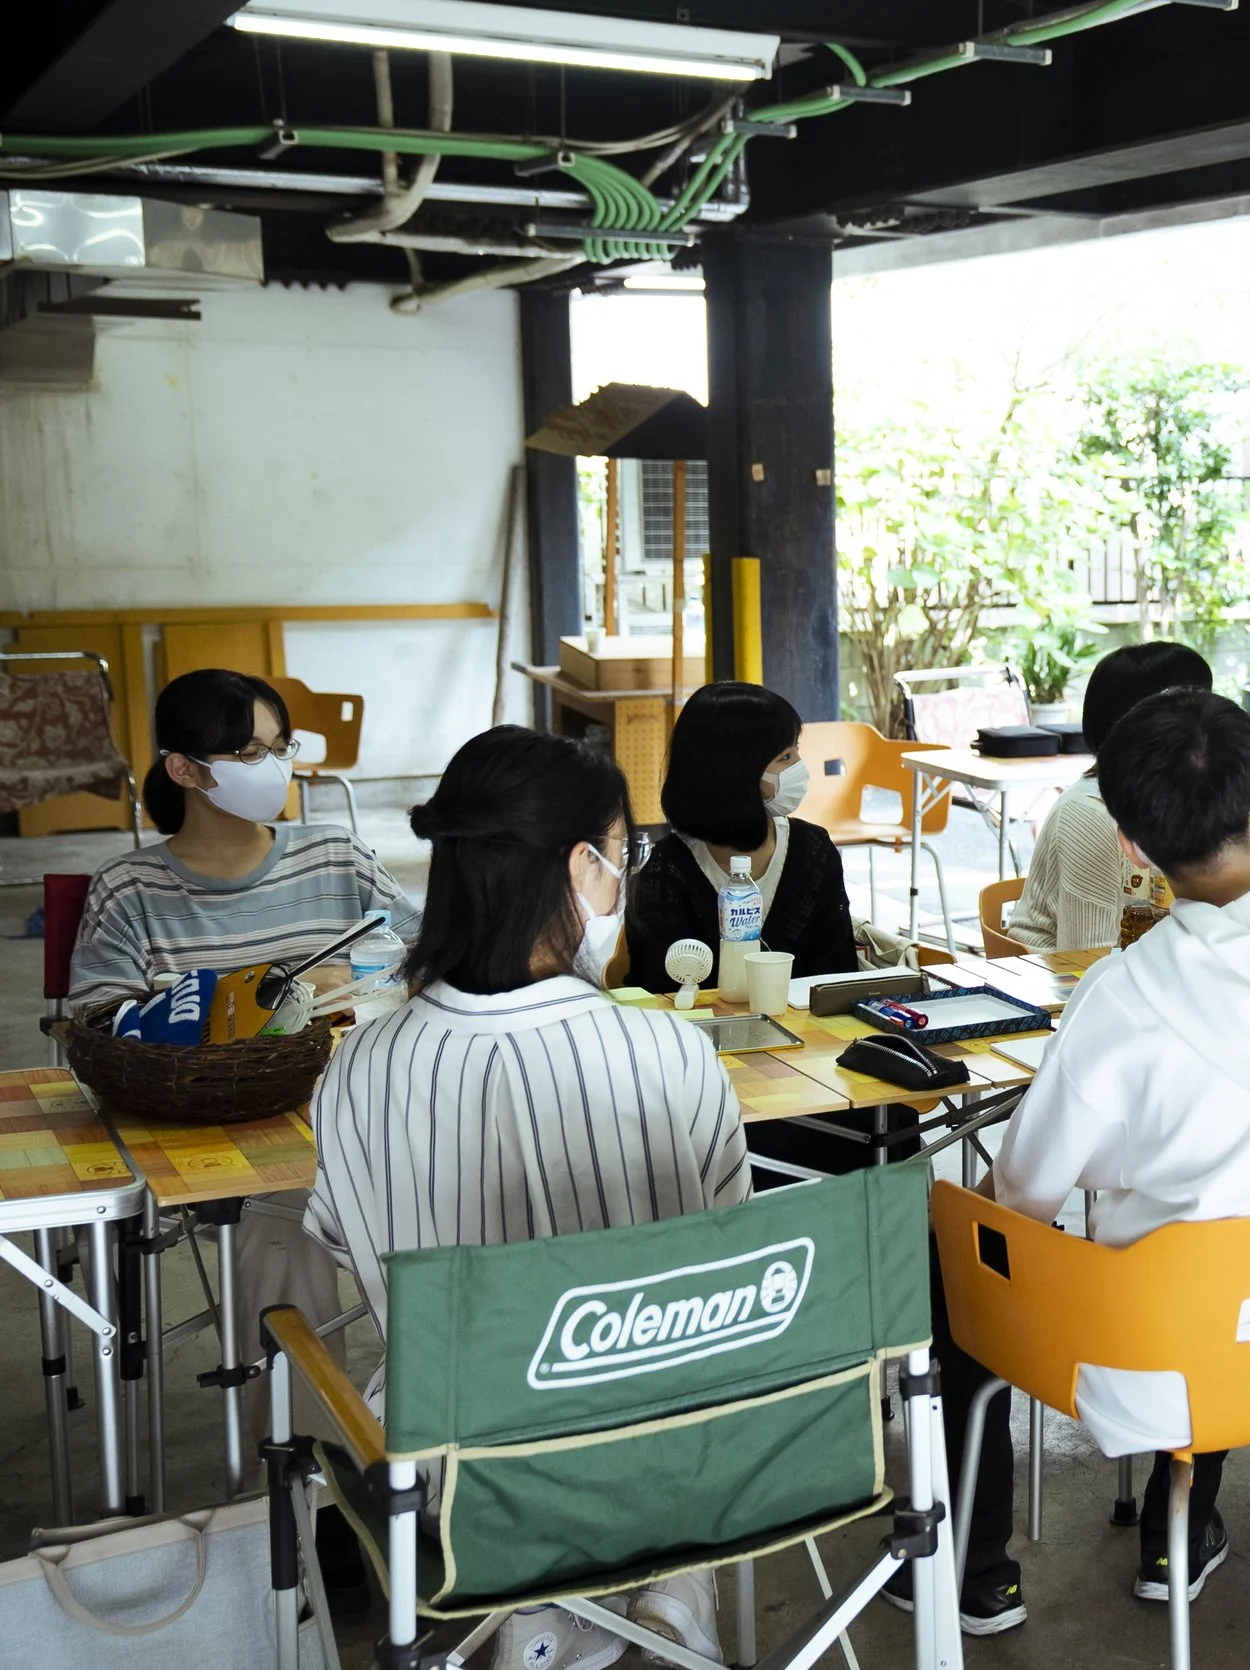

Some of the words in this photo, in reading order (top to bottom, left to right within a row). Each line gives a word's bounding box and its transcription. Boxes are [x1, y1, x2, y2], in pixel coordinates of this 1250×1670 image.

[730, 907, 761, 916] カルピス
[729, 915, 761, 928] Water
[560, 1285, 758, 1361] Coleman
